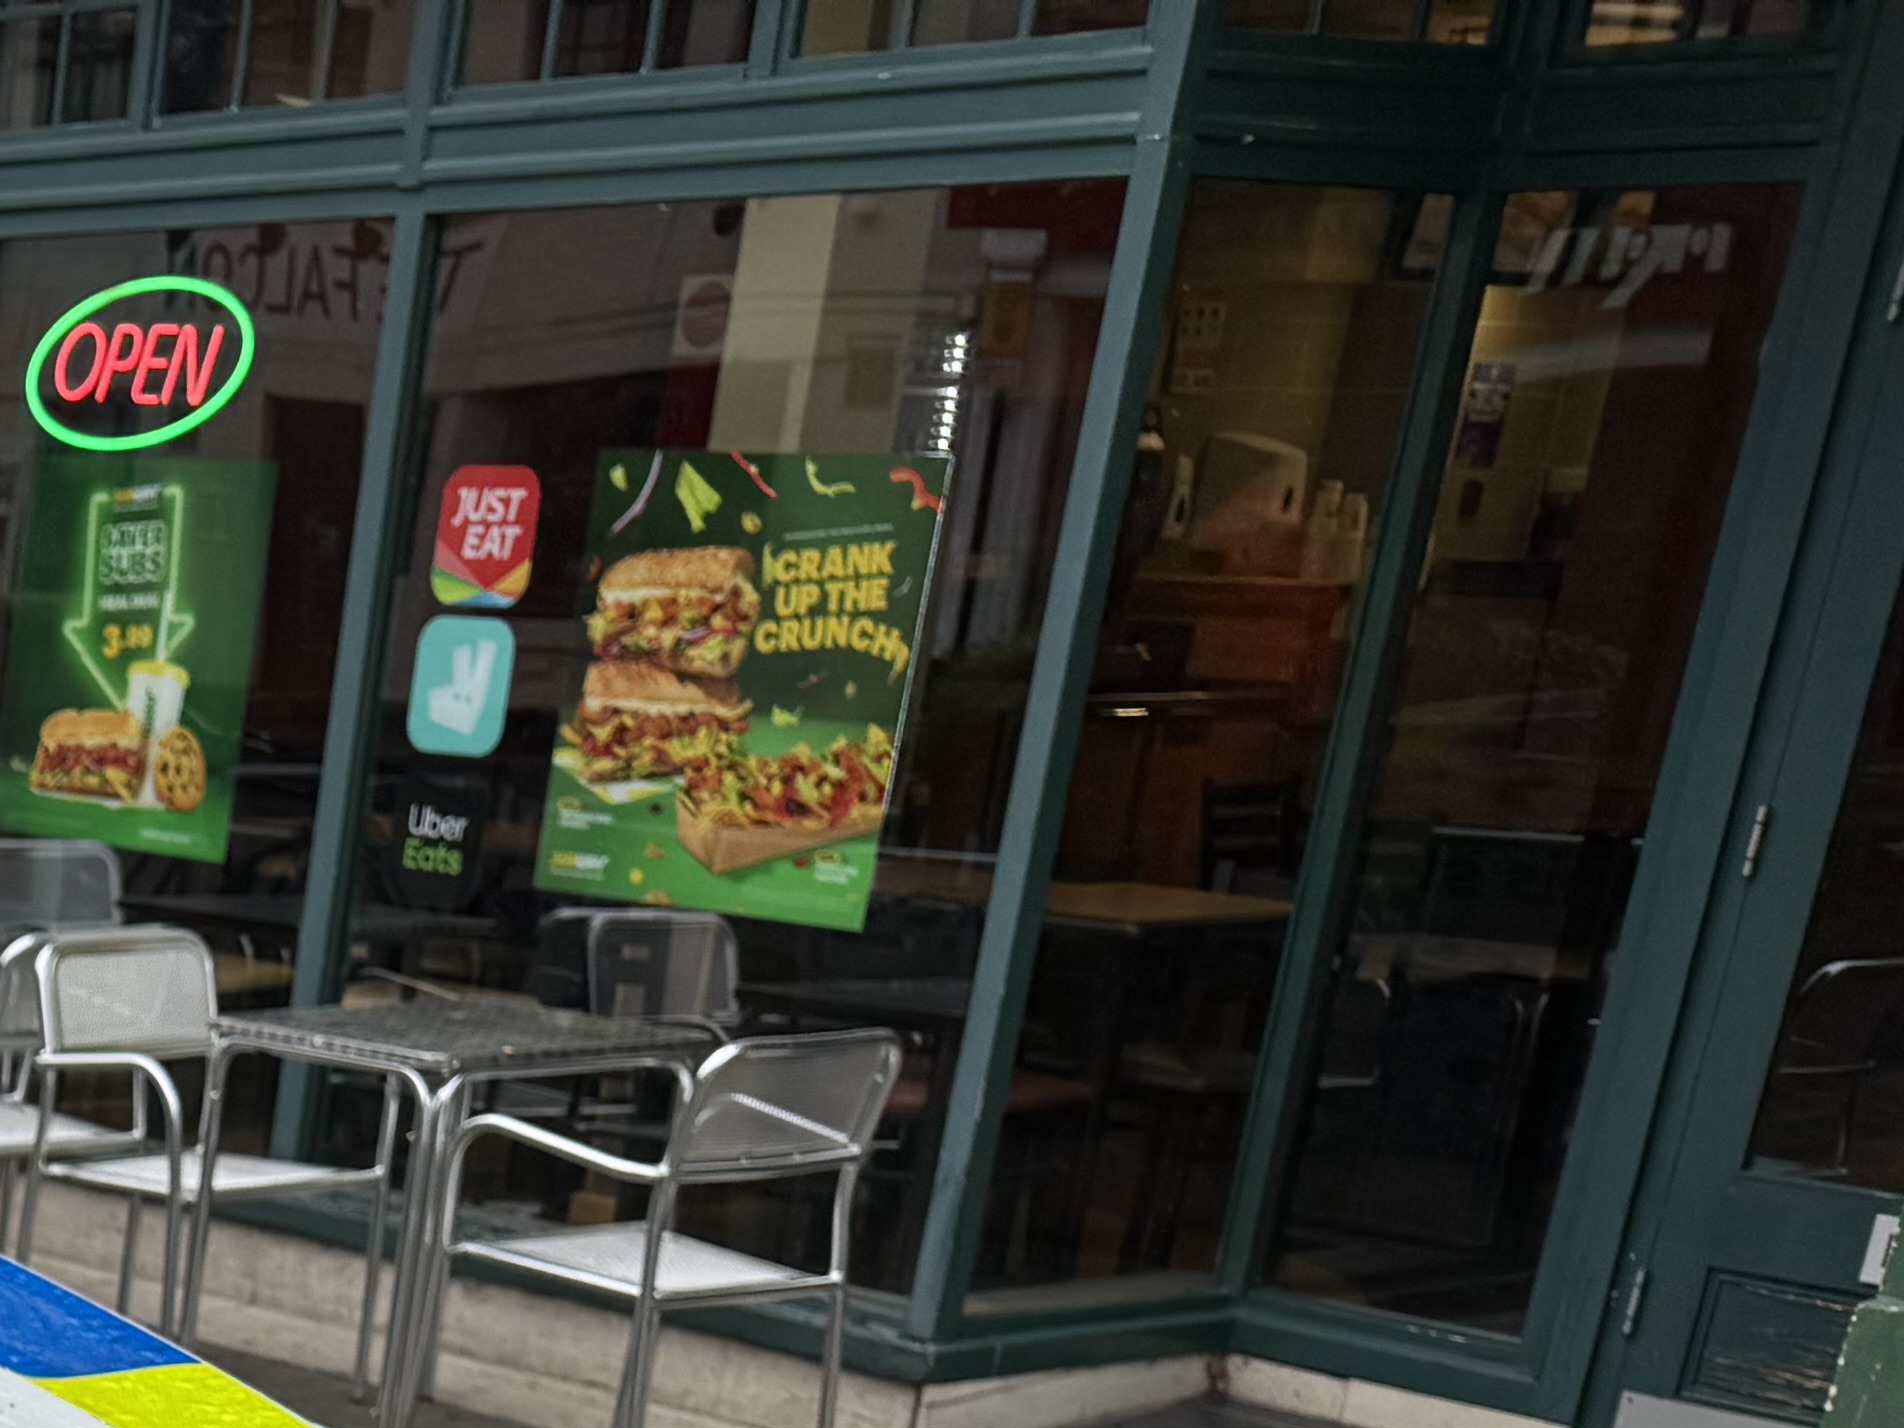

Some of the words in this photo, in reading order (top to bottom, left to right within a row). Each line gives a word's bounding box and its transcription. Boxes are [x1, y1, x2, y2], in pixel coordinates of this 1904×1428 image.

[54, 321, 225, 408] OPEN
[450, 486, 528, 528] JUST
[461, 523, 524, 561] EAT
[772, 540, 896, 584] CRANK
[774, 582, 822, 618] UP
[824, 577, 890, 614] THE
[408, 803, 470, 842] Uber
[402, 837, 464, 876] Eats
